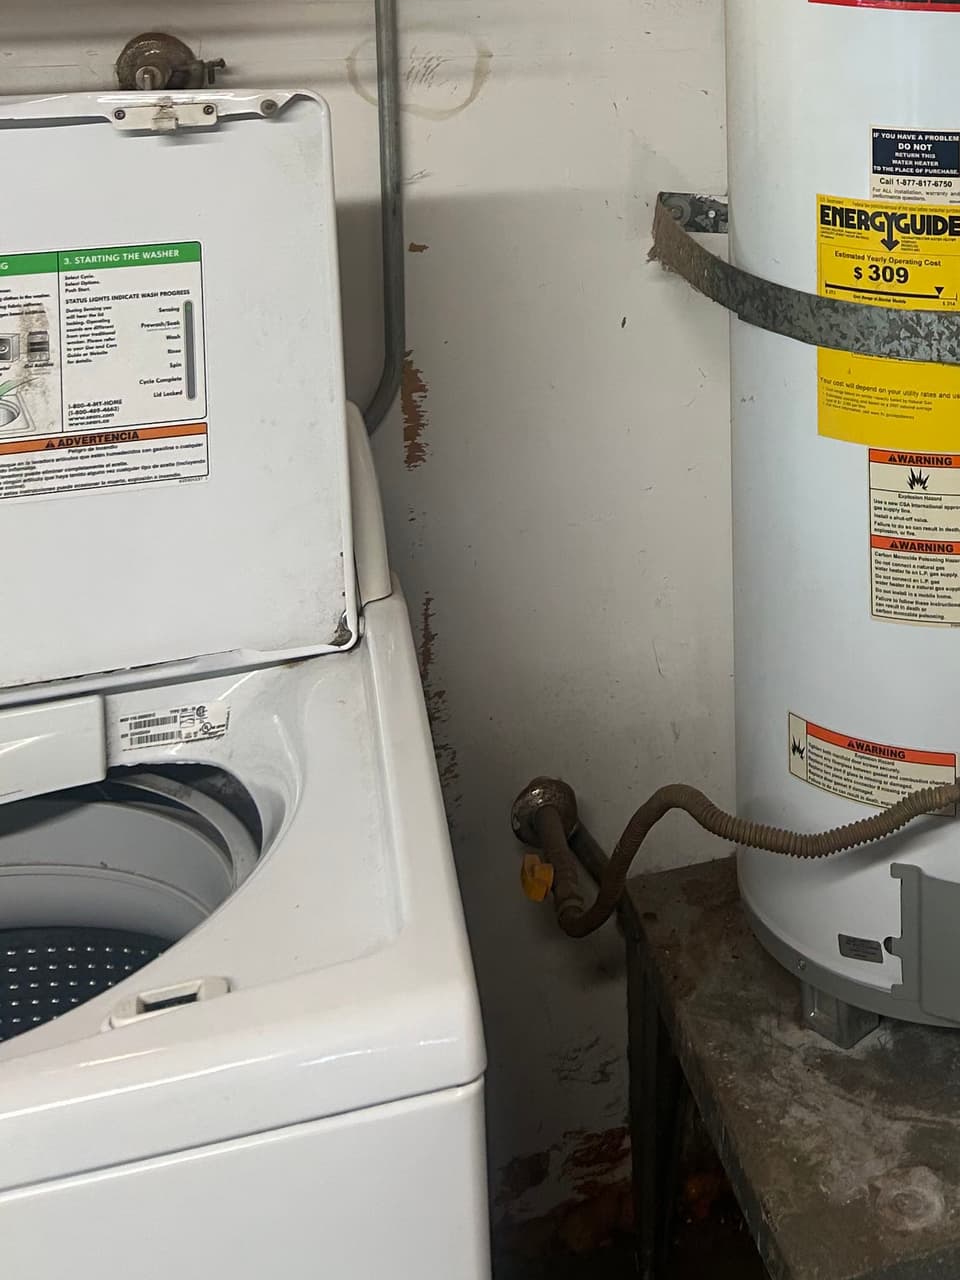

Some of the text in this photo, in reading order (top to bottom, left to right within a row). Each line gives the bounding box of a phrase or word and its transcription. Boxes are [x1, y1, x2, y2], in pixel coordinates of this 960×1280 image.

[898, 142, 933, 151] DO NOT
[879, 177, 894, 185] Call
[75, 253, 120, 265] STARTING
[122, 253, 140, 261] THE
[142, 249, 180, 259] WASHER
[834, 251, 941, 267] Estimated Yearly Operating Cost
[853, 264, 909, 284] $ 309
[65, 297, 87, 305] STATUS
[111, 293, 139, 301] INDICATE
[159, 289, 190, 297] PROGRESS
[156, 376, 182, 384] Complete
[855, 384, 878, 393] depend
[902, 389, 919, 398] utility
[57, 431, 140, 448] ADVERTENCIA
[897, 454, 953, 466] WARNING
[899, 540, 954, 553] WARNING
[855, 740, 906, 760] WARNING
